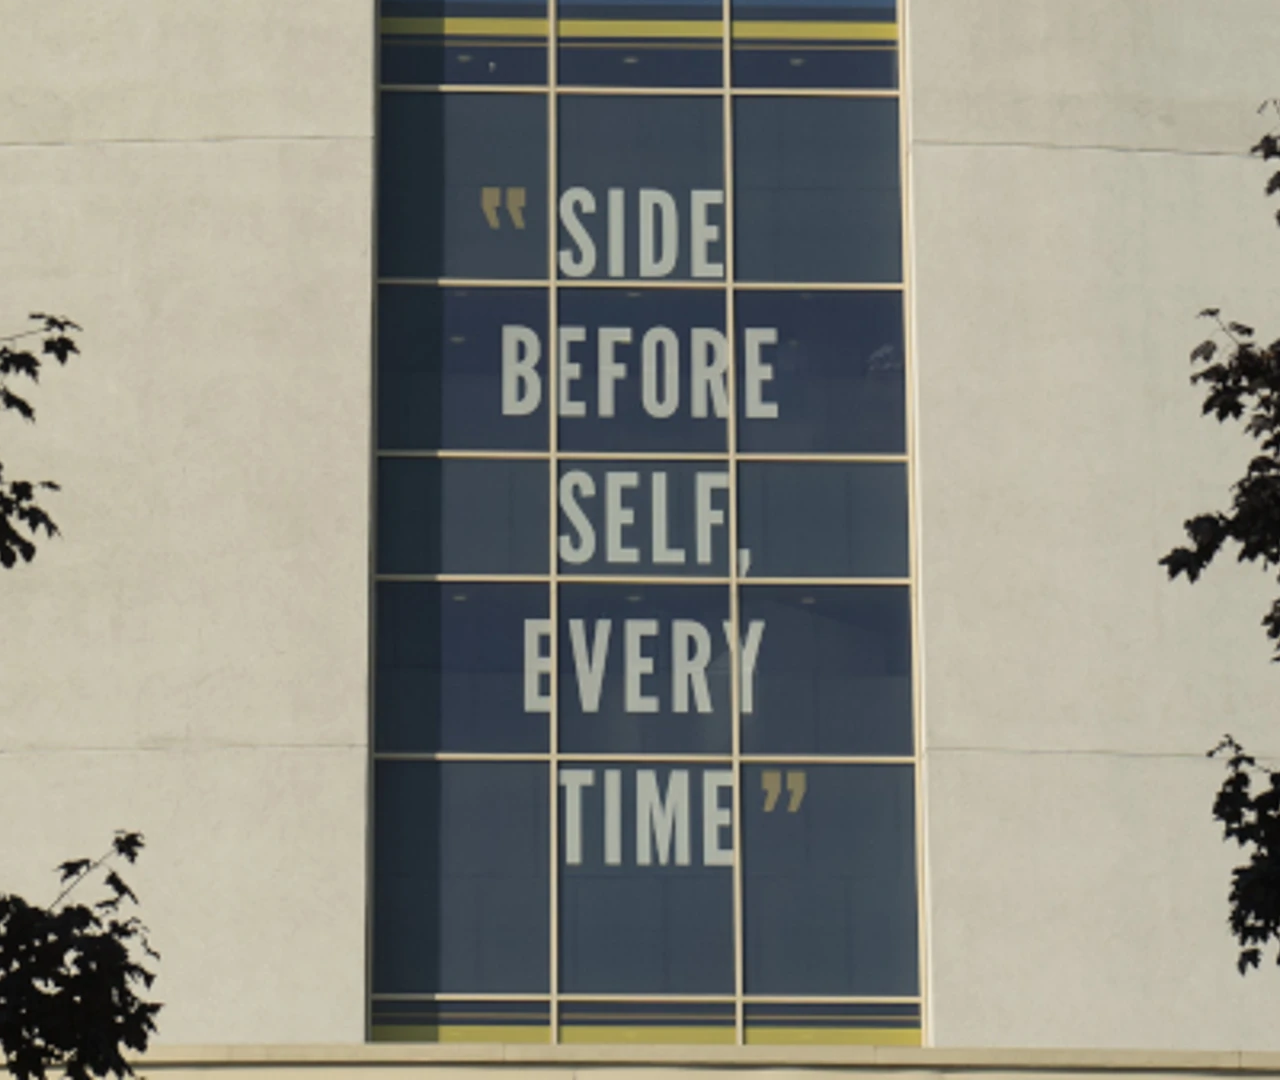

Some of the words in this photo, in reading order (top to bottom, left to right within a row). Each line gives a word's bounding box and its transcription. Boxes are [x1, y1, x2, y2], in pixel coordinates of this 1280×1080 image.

[501, 324, 779, 419] BEFORE
[558, 469, 751, 578] SELF,
[523, 618, 765, 713] EVERY
